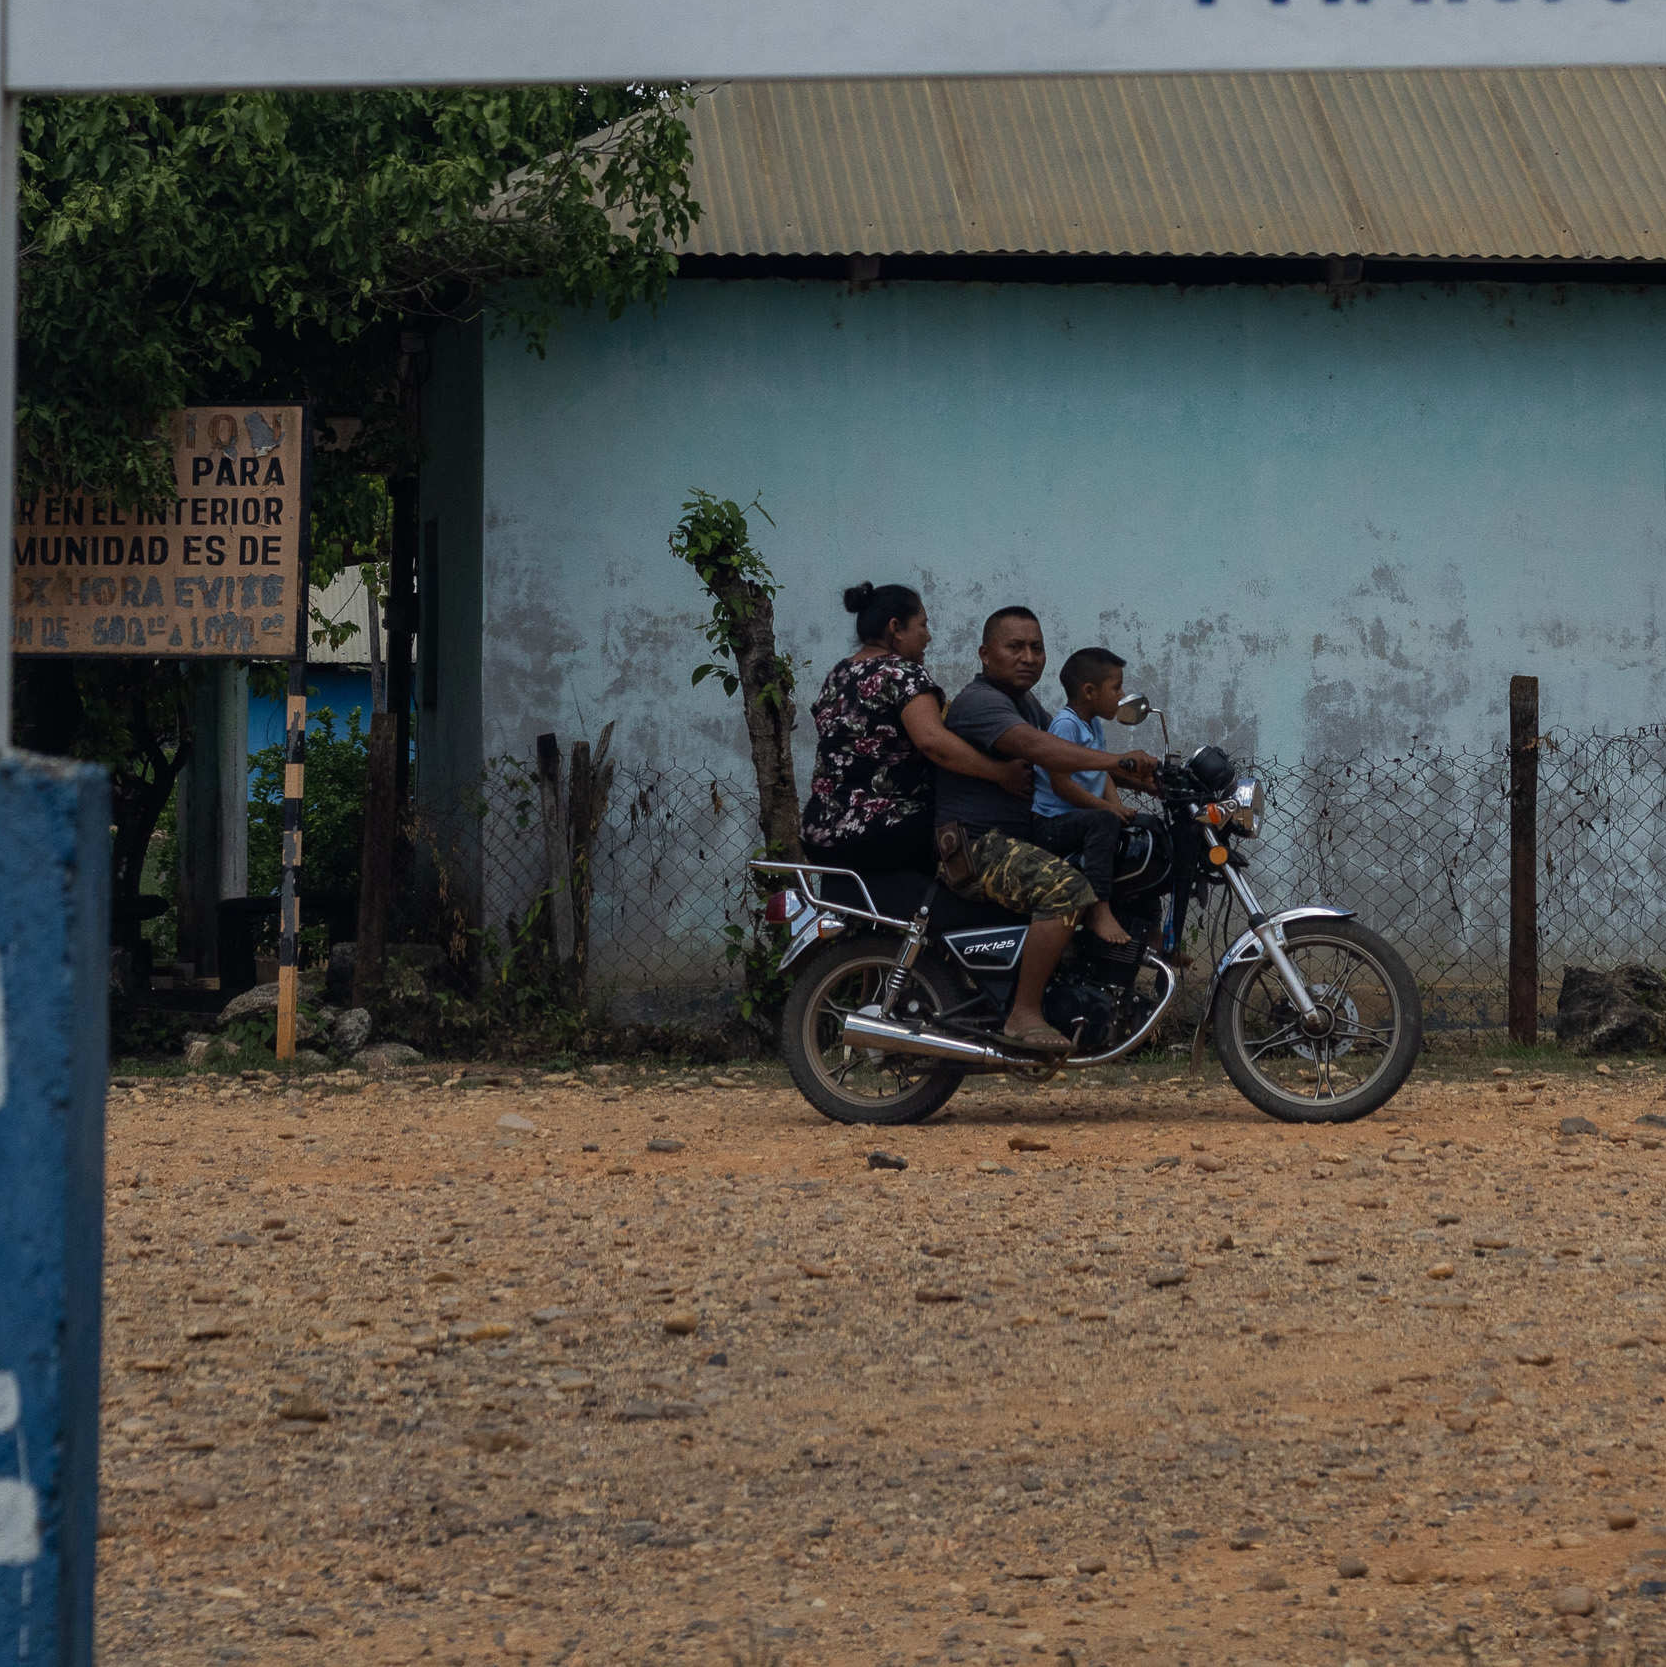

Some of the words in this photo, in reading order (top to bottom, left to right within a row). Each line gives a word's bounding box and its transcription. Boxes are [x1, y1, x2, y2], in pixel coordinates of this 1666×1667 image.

[191, 457, 286, 486] PARA
[45, 497, 83, 526] EN
[92, 497, 127, 526] EL
[137, 497, 283, 526] INTERIOR
[14, 535, 169, 566] MUNIDAD
[183, 535, 226, 566] ES
[239, 535, 282, 566] DE
[66, 575, 164, 607] HORA
[963, 939, 1016, 955] GTK125
